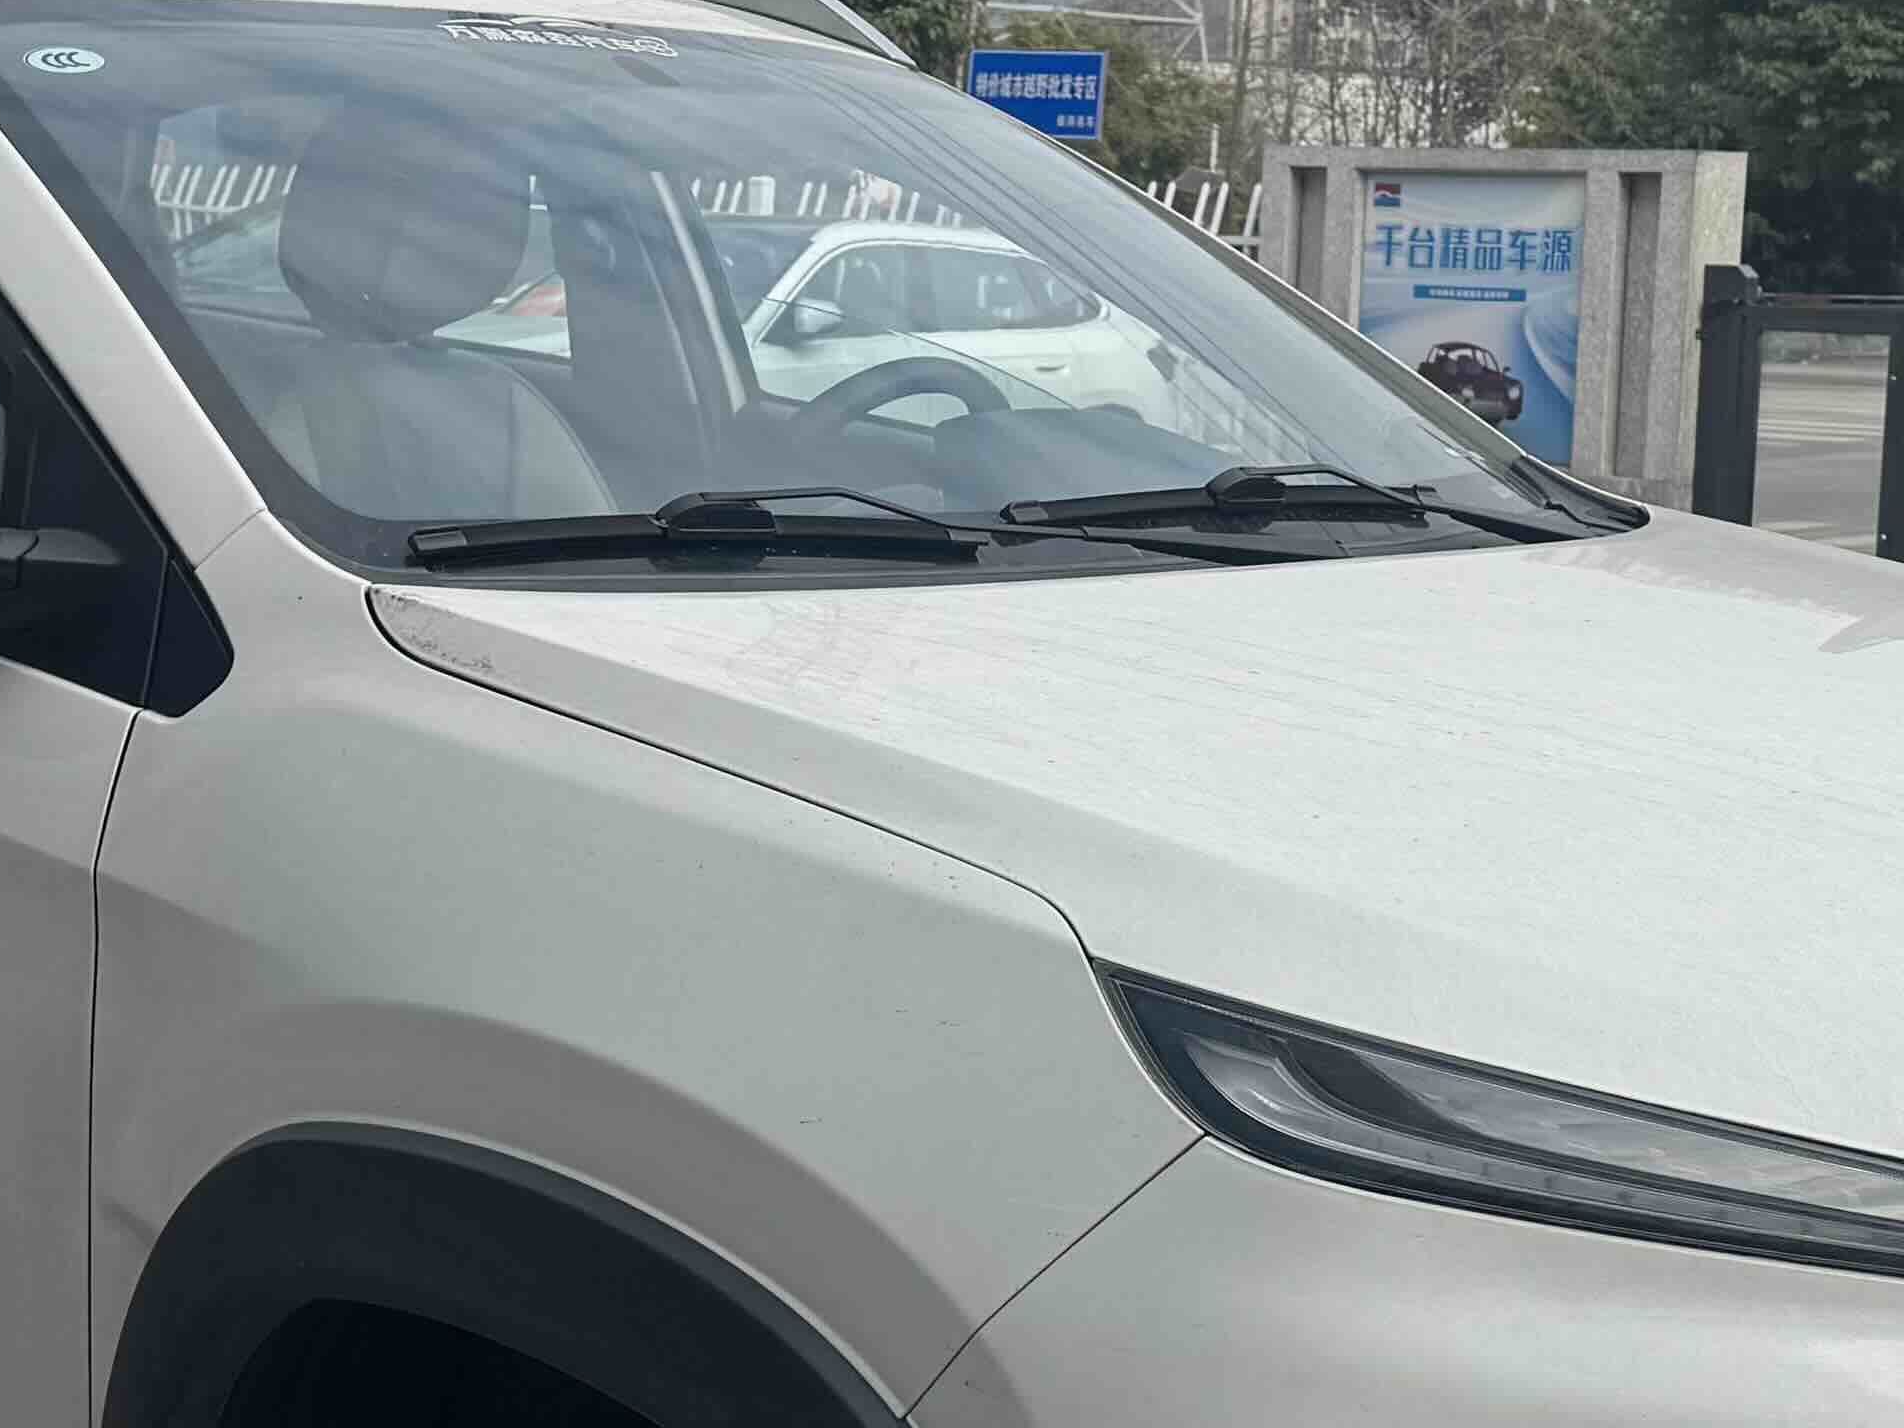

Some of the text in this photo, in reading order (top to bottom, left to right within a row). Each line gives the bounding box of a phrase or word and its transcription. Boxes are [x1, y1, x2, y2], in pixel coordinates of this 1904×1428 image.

[1374, 225, 1573, 273] 千台精品车源
